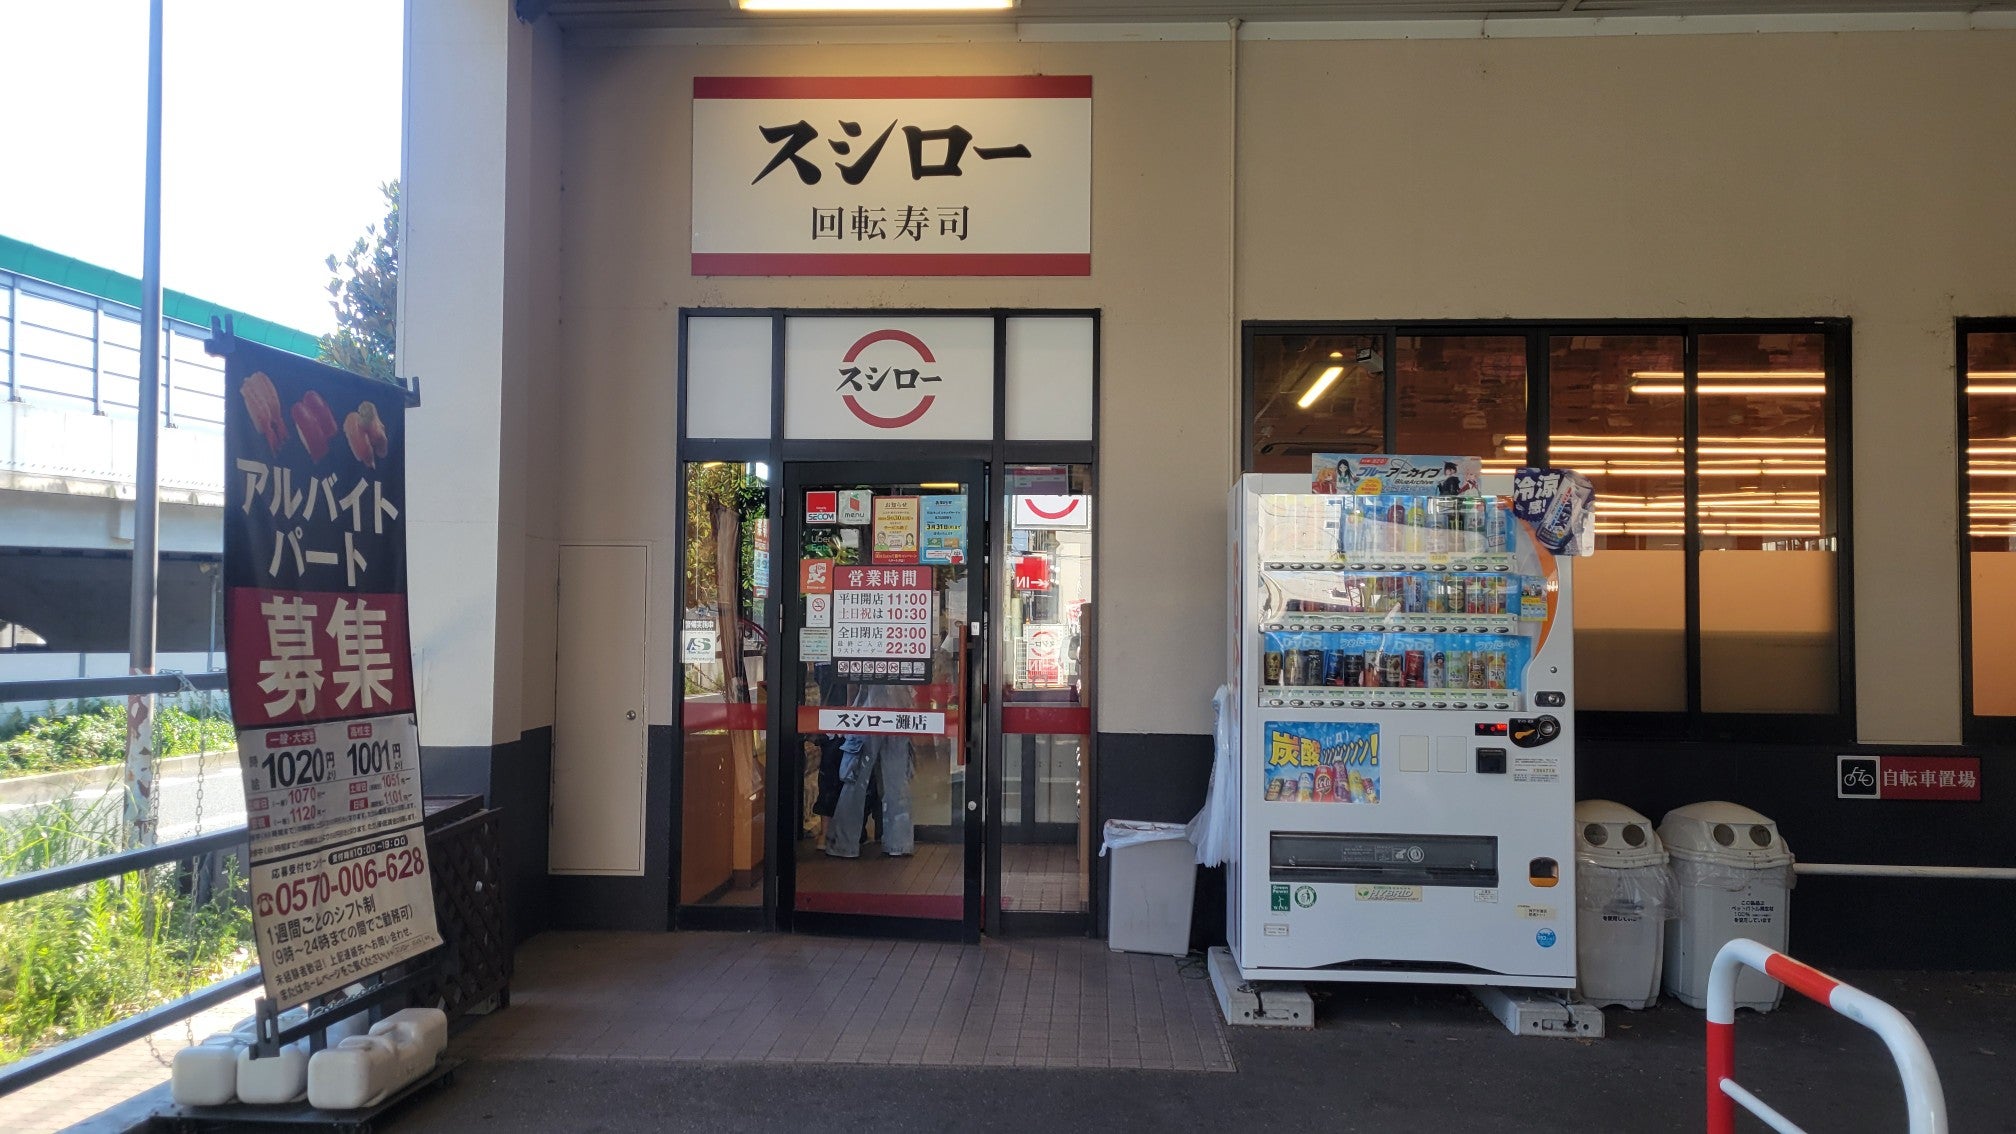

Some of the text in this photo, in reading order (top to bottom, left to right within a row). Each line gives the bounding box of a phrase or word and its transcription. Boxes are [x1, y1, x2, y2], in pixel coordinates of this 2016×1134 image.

[751, 118, 1032, 185] スシロー
[812, 205, 970, 242] 回転寿司
[836, 366, 942, 391] スシロー
[236, 457, 399, 534] アルバイト
[268, 526, 367, 587] パート
[848, 570, 917, 587] 営業時間
[838, 593, 927, 605] 平日開店 11:00
[838, 608, 927, 620] 土日祝は 10:30
[838, 627, 927, 639] 全日閉店 23:00
[257, 595, 394, 718] 募集
[885, 642, 926, 654] 22:30
[836, 713, 927, 731] スシロー灘店
[1883, 769, 1976, 788] 自転車置場
[275, 846, 425, 916] 0570-006-628
[266, 894, 376, 946] 1週間ごとのシフト制
